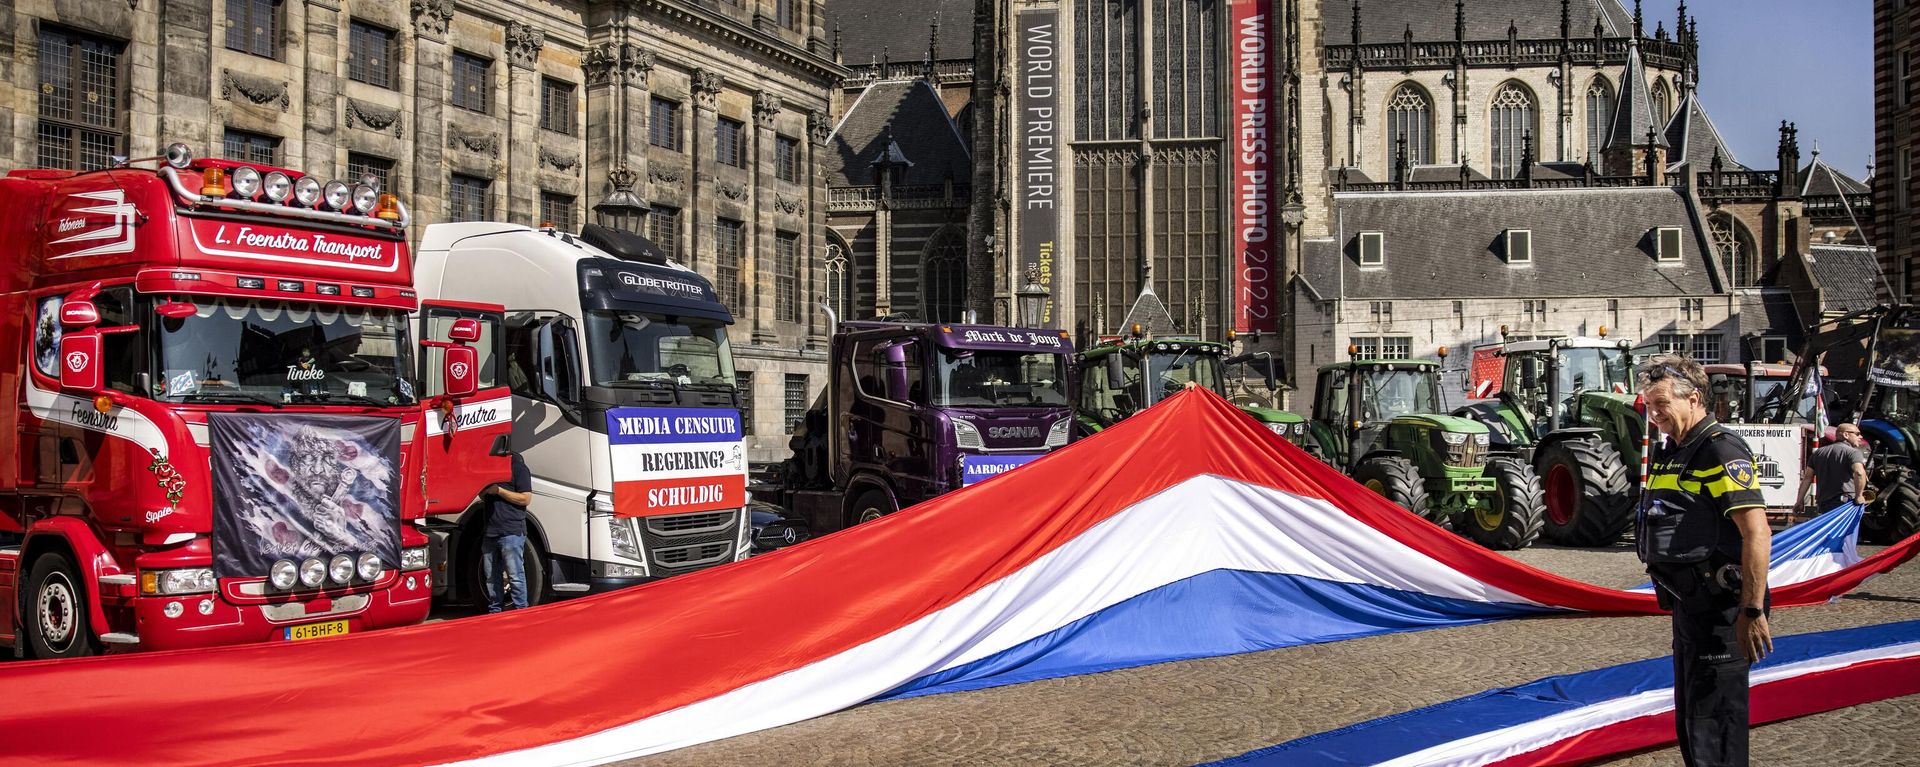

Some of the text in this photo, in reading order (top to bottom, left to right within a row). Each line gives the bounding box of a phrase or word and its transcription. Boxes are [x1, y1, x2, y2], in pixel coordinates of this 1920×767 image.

[1027, 23, 1053, 210] WORLD PREMIERE
[1241, 14, 1268, 320] WORLD PRESS PHOTO 2022
[215, 225, 382, 261] L. Feenstra Transport
[1040, 241, 1053, 284] Tickets
[624, 276, 703, 295] GLOBETROTTER
[965, 330, 1062, 348] Mark de Jong
[286, 364, 325, 380] Tineke
[72, 400, 118, 431] Feenstra
[618, 416, 736, 435] MEDIA CENSUUR
[988, 426, 1040, 439] SCANIA
[1766, 429, 1784, 438] MOVE
[1785, 429, 1792, 438] IT
[642, 450, 724, 472] REGERING?
[648, 484, 723, 508] SCHULDIG
[296, 622, 343, 639] 61-BHF-8
